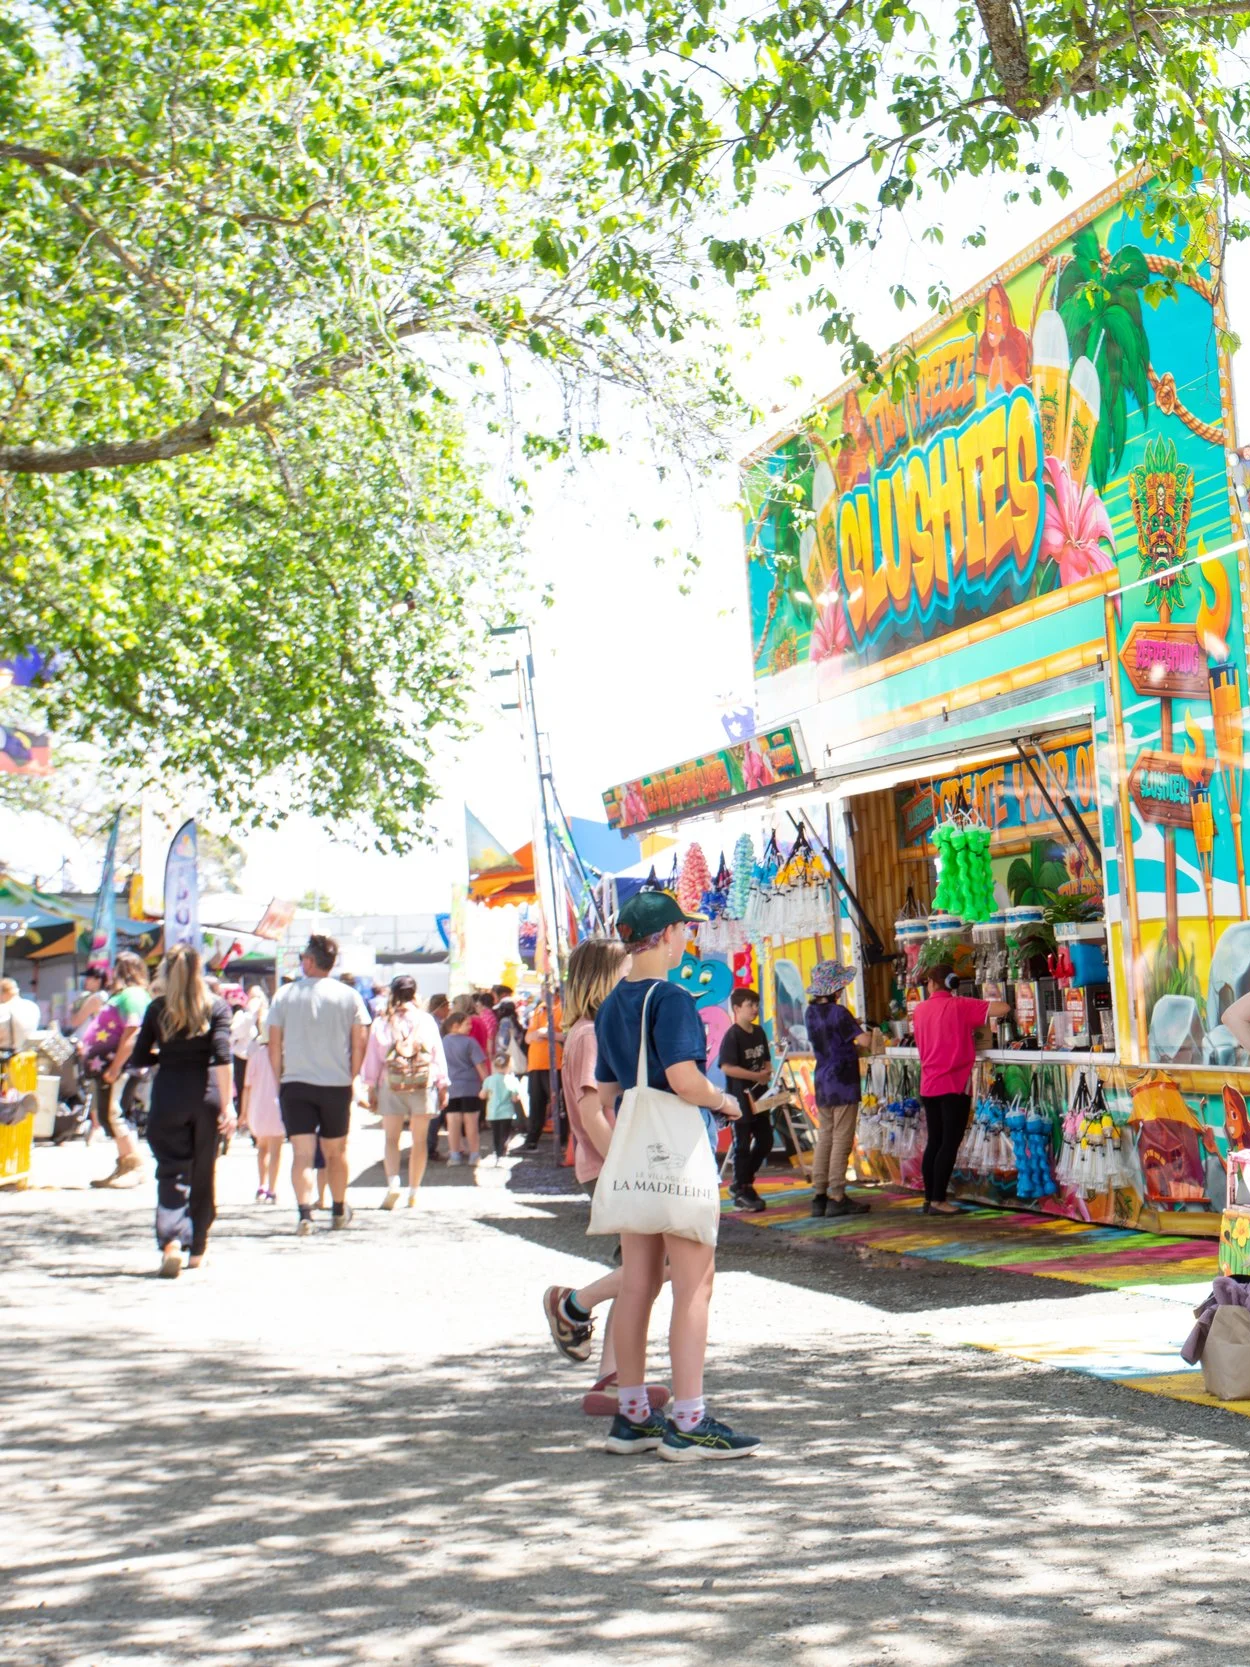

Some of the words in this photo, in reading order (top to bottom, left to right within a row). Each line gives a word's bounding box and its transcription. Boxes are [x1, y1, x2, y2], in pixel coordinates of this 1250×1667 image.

[840, 393, 1040, 628] SLUSHIES
[1013, 750, 1069, 822] YOUR
[613, 1179, 630, 1192] LA
